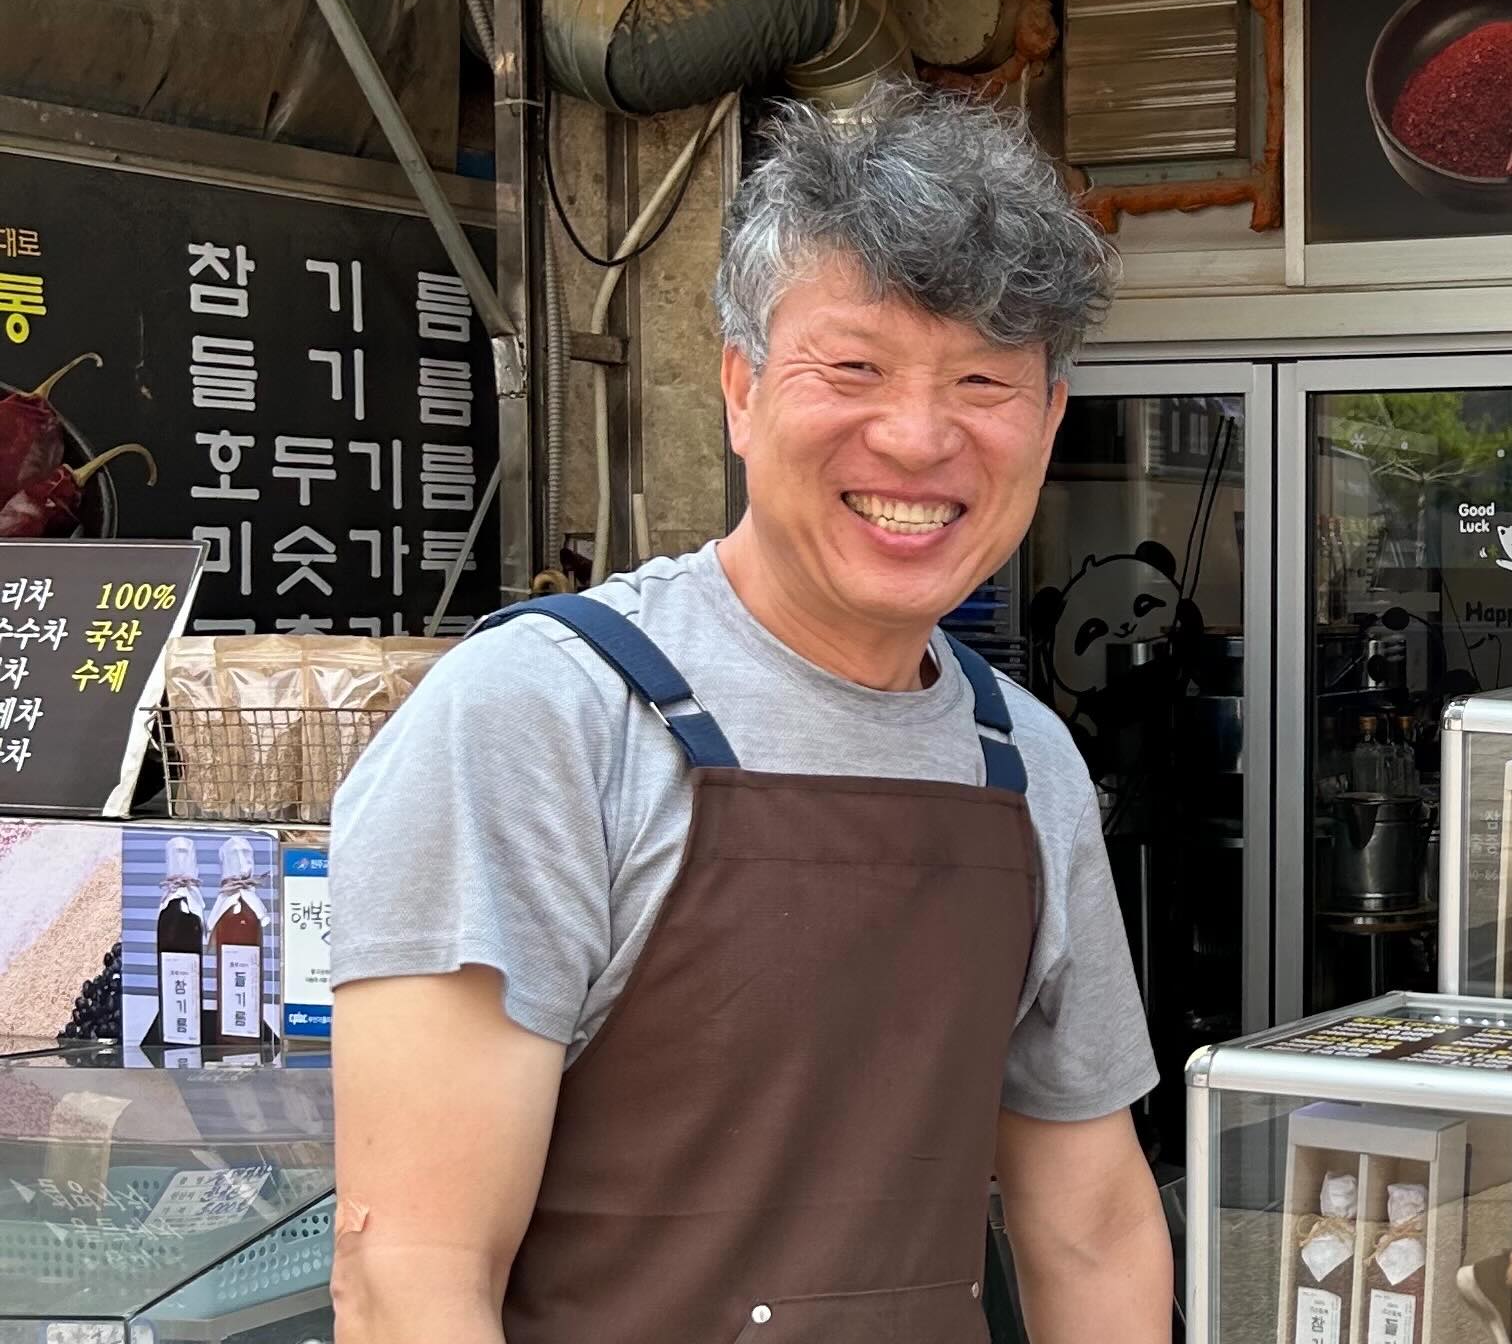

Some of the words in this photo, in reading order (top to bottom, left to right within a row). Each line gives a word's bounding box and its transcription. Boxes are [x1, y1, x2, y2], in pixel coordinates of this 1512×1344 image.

[191, 430, 477, 511] 호두기름
[1459, 502, 1495, 516] Good
[1460, 519, 1490, 533] Luck
[96, 582, 177, 611] 100%
[85, 619, 142, 652] 국산
[72, 659, 129, 693] 수제
